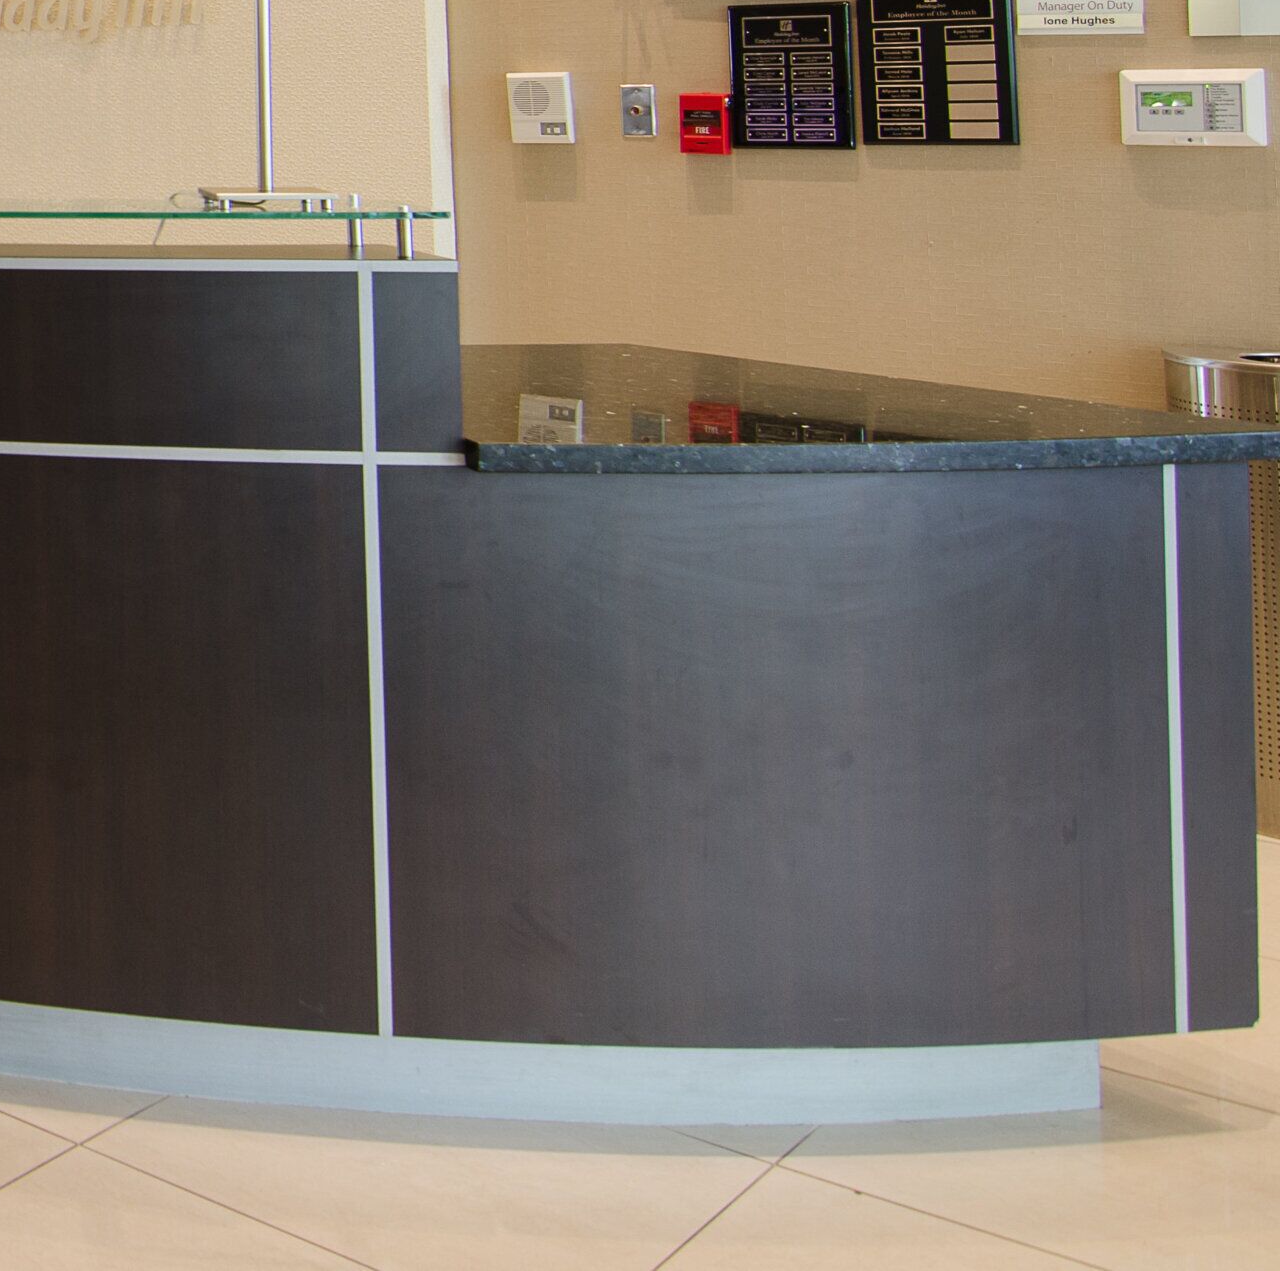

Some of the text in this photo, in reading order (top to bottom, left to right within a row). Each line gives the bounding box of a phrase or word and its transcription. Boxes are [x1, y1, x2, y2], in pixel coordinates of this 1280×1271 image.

[1037, 0, 1134, 13] Manager On Duty
[888, 11, 925, 19] Employee
[951, 9, 977, 17] Month
[1043, 15, 1115, 26] Ione Hughes
[695, 126, 710, 134] FIRE
